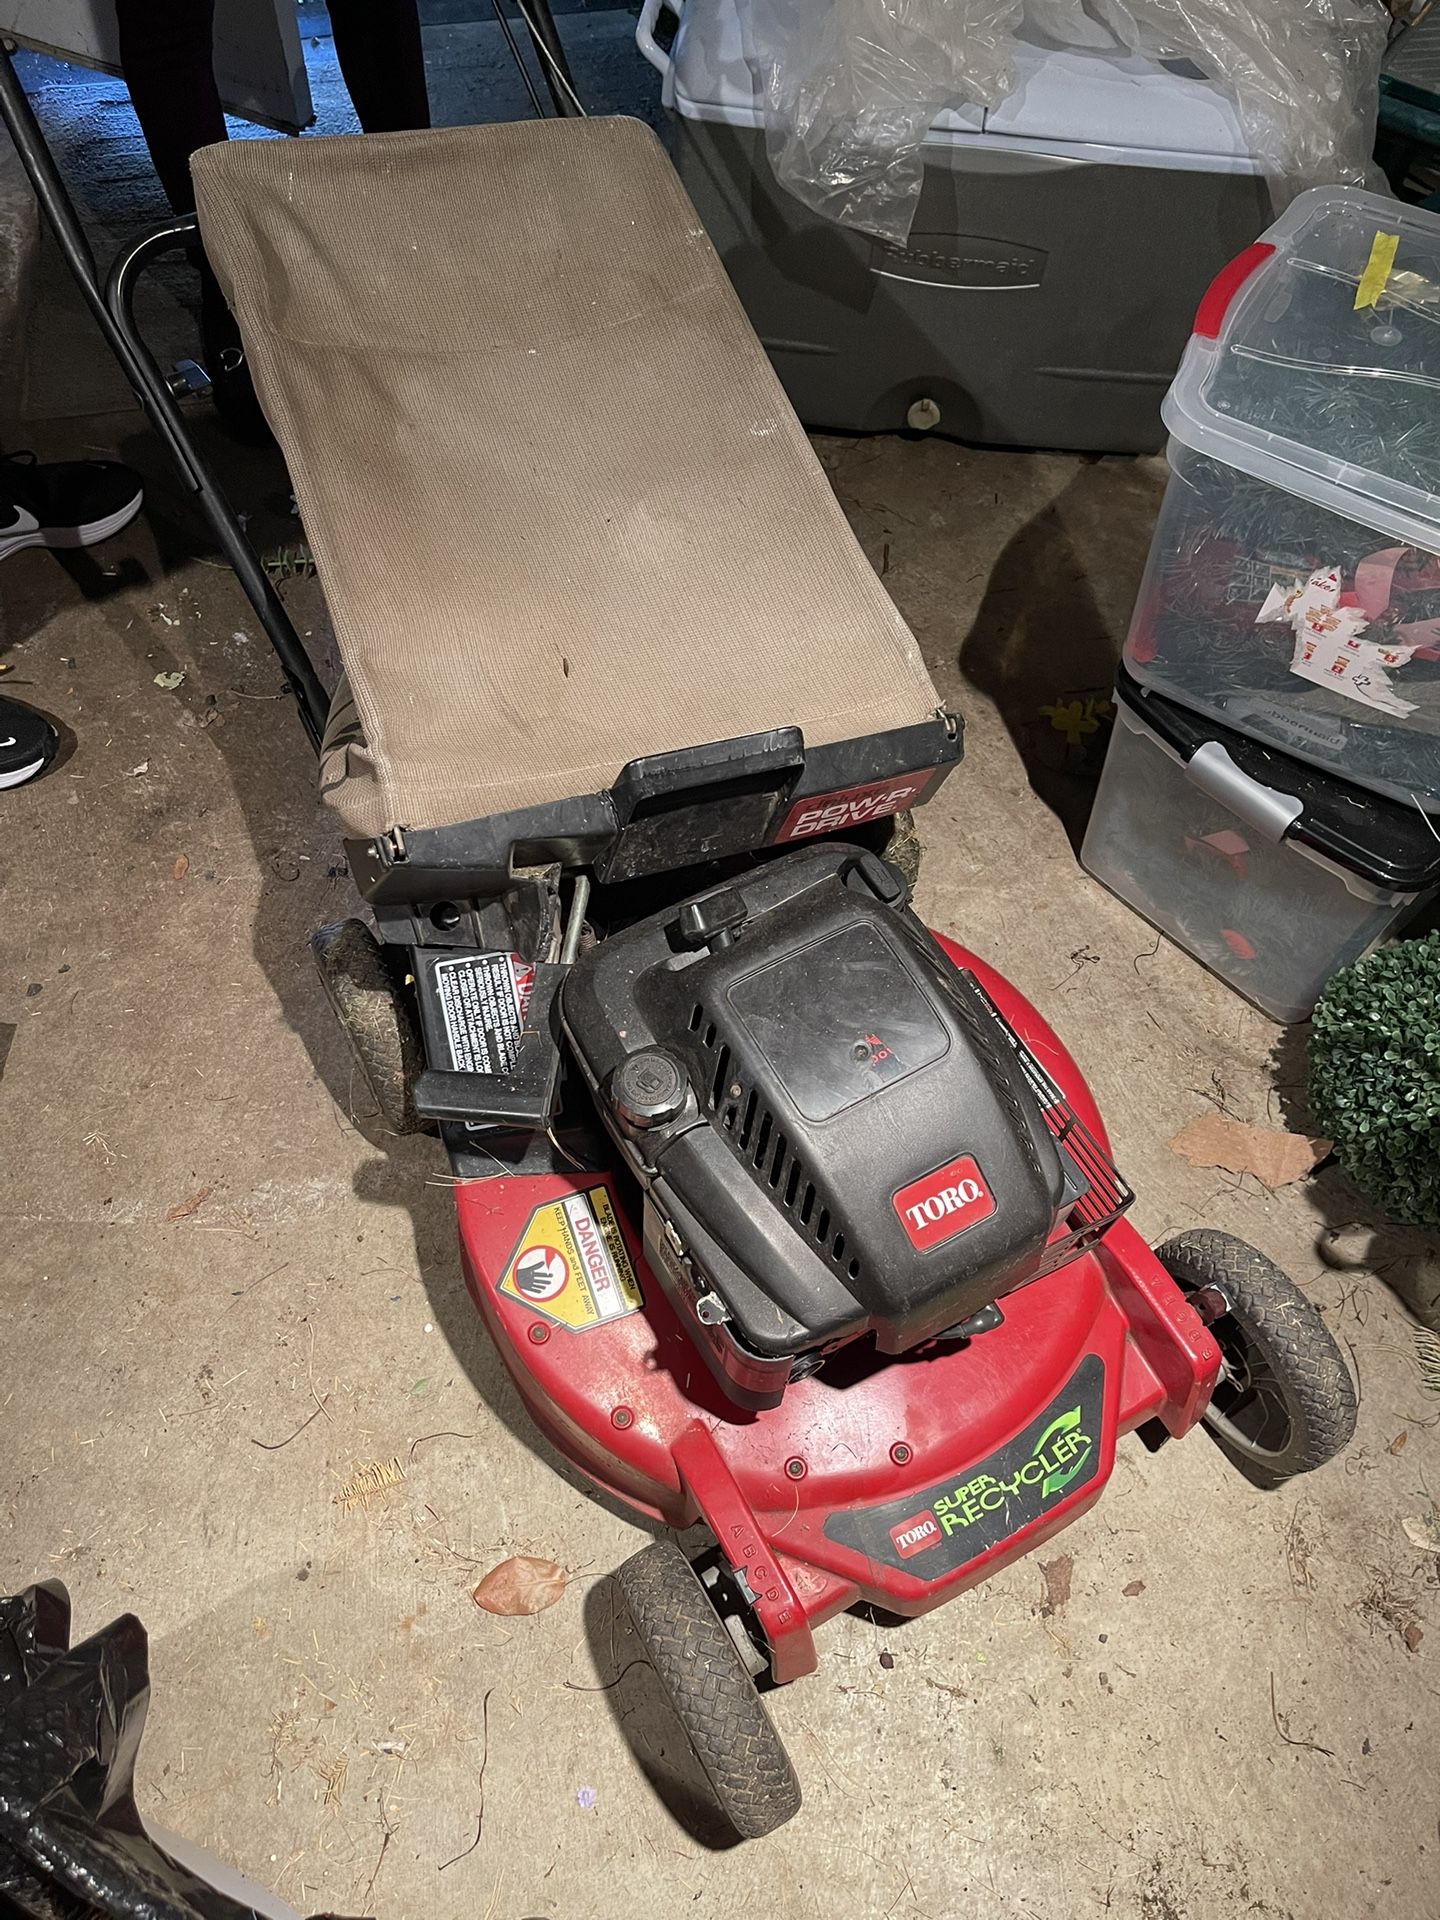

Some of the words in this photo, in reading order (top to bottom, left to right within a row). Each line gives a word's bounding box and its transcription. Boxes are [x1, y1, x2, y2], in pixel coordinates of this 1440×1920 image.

[790, 801, 895, 838] DRIVE
[441, 973, 452, 1000] MOVING
[465, 968, 478, 1001] OPERATE
[482, 965, 494, 996] THROWN
[499, 962, 511, 993] THROWN
[446, 1000, 456, 1021] DOOR
[448, 971, 459, 995] CLEAR
[461, 1035, 471, 1053] WITH
[463, 998, 471, 1009] OR
[471, 1001, 482, 1020] ONLY
[488, 996, 501, 1028] OBJECTS
[450, 1021, 462, 1049] HANDLE
[494, 1027, 504, 1043] AND
[498, 998, 508, 1018] DOOR
[503, 1026, 512, 1041] NOT
[477, 1027, 487, 1048] DOOR
[455, 1049, 466, 1070] BACK
[497, 1043, 508, 1067] BLADE
[906, 1178, 980, 1231] TORO
[553, 1206, 566, 1227] KEEP
[560, 1228, 575, 1255] HANDS
[569, 1256, 580, 1270] and
[575, 1271, 587, 1292] FEET
[581, 1294, 594, 1316] AWAY
[575, 1216, 611, 1292] DANGER
[611, 1251, 626, 1282] RUNNING
[613, 1234, 629, 1268] ROTATING
[624, 1268, 636, 1290] WHEN
[933, 1474, 997, 1516] SUPER
[940, 1430, 1093, 1537] RECYCLER
[896, 1520, 937, 1550] TORO
